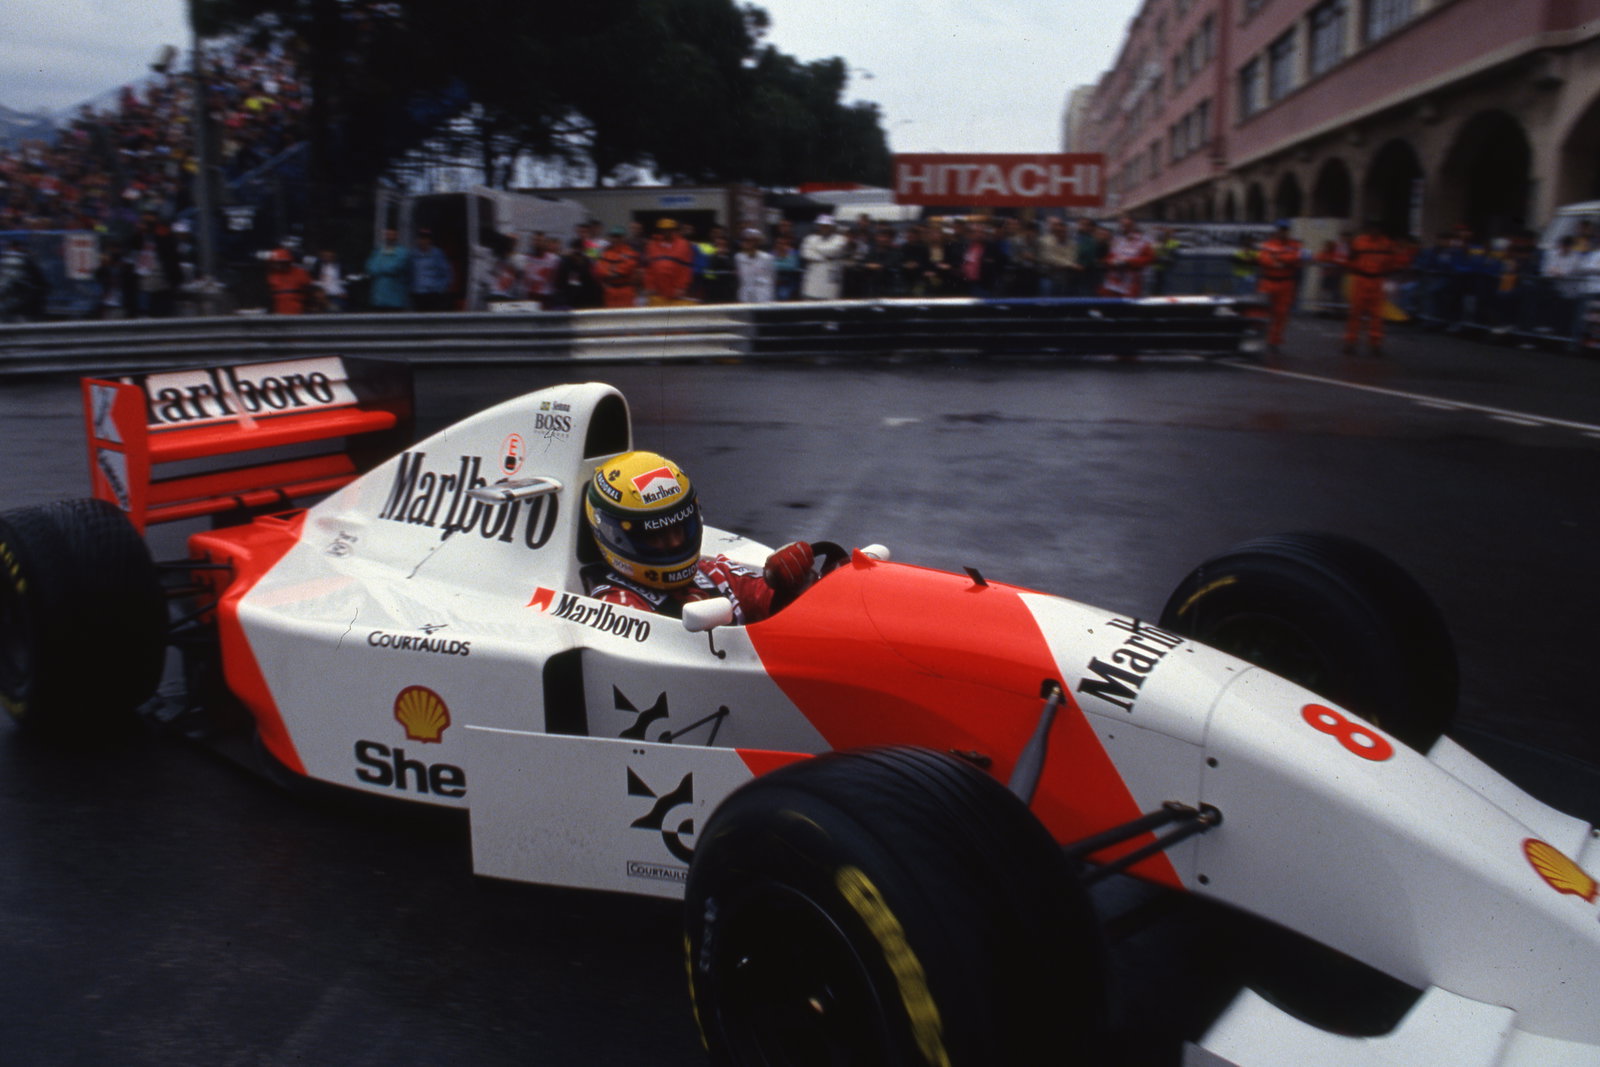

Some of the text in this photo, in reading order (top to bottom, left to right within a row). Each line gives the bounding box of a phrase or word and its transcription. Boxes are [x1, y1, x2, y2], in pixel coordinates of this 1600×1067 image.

[899, 163, 1101, 196] HITACHI
[535, 413, 572, 432] BOSS
[378, 451, 560, 549] Marlboro
[642, 485, 681, 505] Marlboro
[643, 503, 695, 531] KENWOOD
[551, 592, 651, 643] Marlboro
[367, 630, 472, 657] COURTAULDS
[1301, 702, 1395, 762] 8
[354, 739, 467, 798] She
